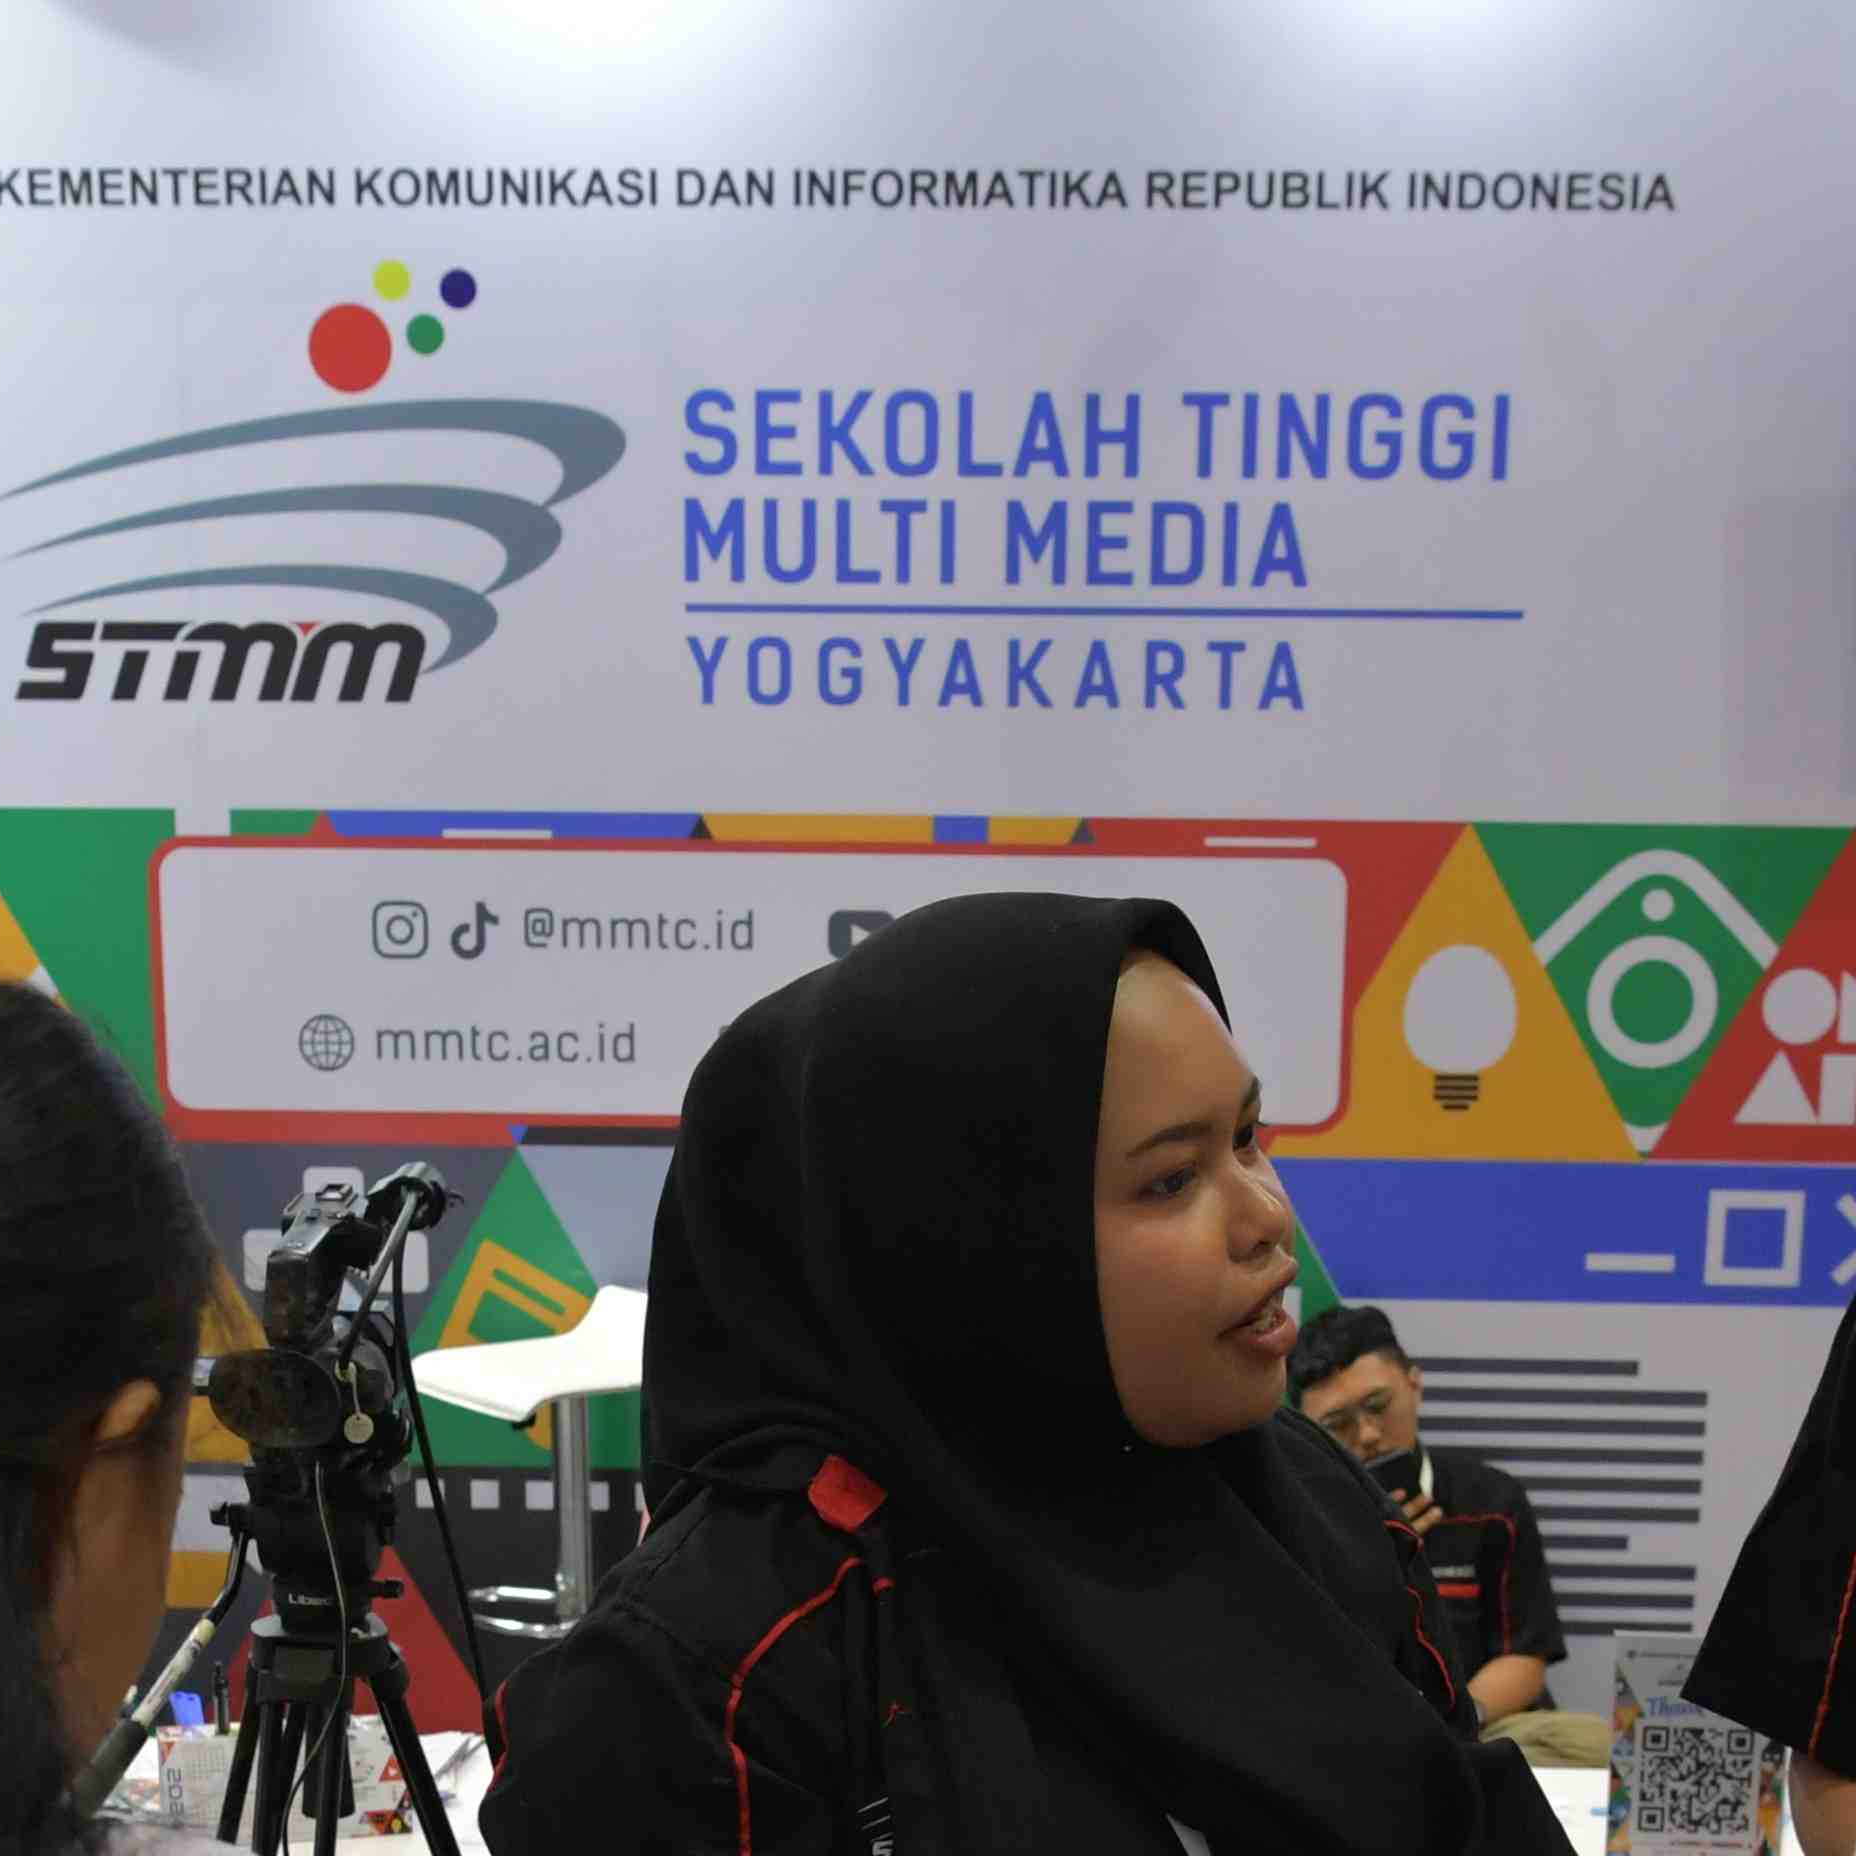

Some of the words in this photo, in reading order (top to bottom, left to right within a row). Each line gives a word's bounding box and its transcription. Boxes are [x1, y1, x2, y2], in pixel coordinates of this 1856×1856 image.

[353, 168, 658, 207] KOMUNIKASI
[675, 168, 775, 208] DAN
[793, 169, 1128, 209] INFORMATIKA
[1144, 170, 1392, 210] REPUBLIK
[1407, 172, 1676, 212] INDONESIA
[683, 388, 1142, 478] SEKOLAH
[1183, 392, 1512, 481] TINGGI
[683, 497, 956, 585] MULTI
[1004, 499, 1308, 588] MEDIA
[685, 634, 1305, 711] YOGYAKARTA
[523, 907, 755, 952] @mmtc.id
[374, 1021, 637, 1064] mmtc.ac.id
